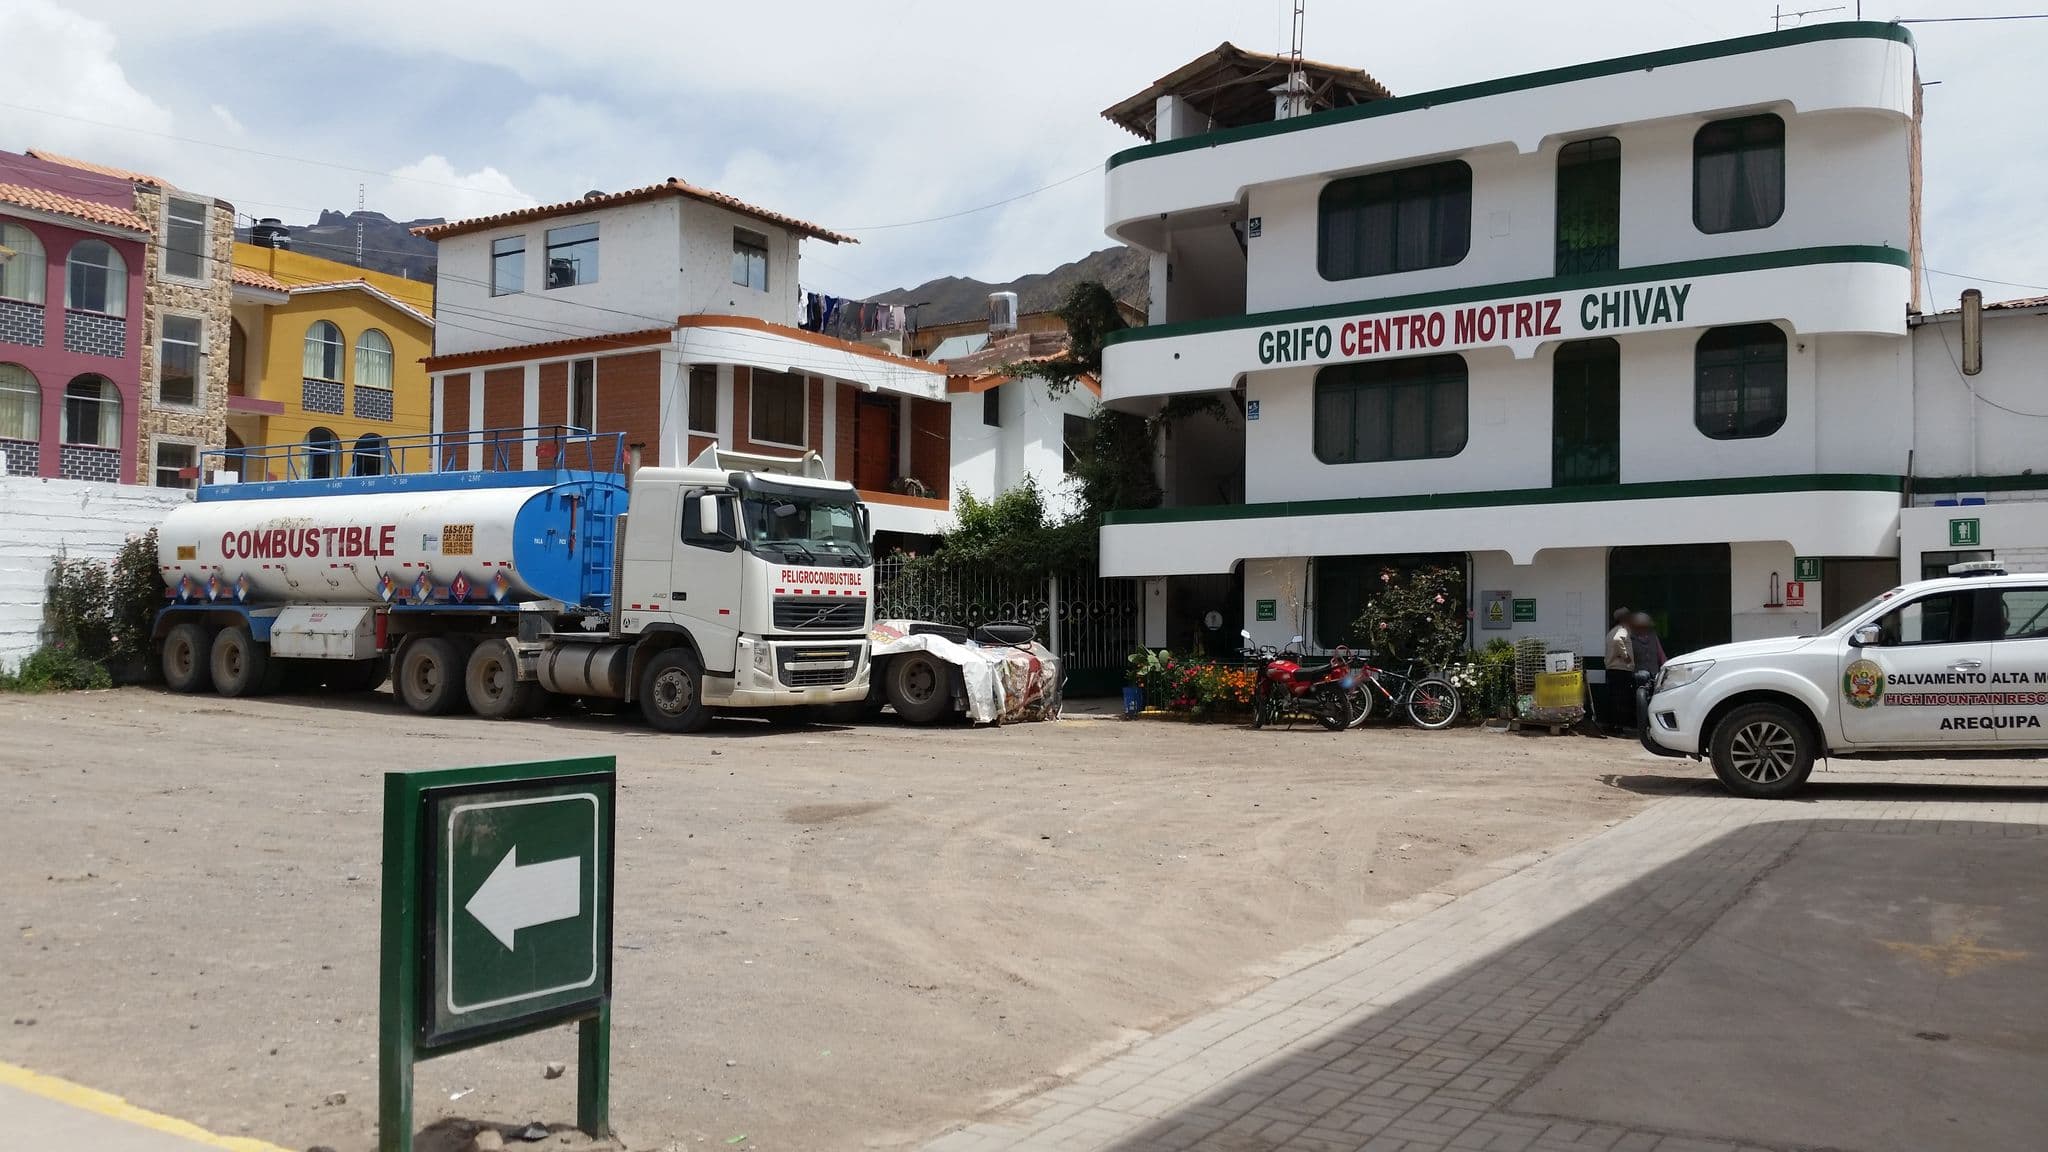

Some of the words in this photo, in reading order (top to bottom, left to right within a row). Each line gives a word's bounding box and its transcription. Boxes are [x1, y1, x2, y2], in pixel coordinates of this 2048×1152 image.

[1258, 325, 1332, 364] GRIFO
[1340, 312, 1445, 357] CENTRO
[1454, 299, 1562, 345] MOTRIZ
[1580, 284, 1692, 331] CHIVAY
[221, 525, 396, 559] COMBUSTIBLE
[781, 569, 862, 586] PELIGROCOMBUSTIBLE
[1887, 673, 1987, 685] SALVAMENTO
[1991, 672, 2029, 684] ALTA
[2034, 672, 2048, 684] M
[1886, 694, 1922, 704] HIGH
[1925, 694, 2003, 704] MOUNTAIN
[2007, 694, 2048, 704] RESC
[1940, 715, 2041, 730] AREQUIPA
